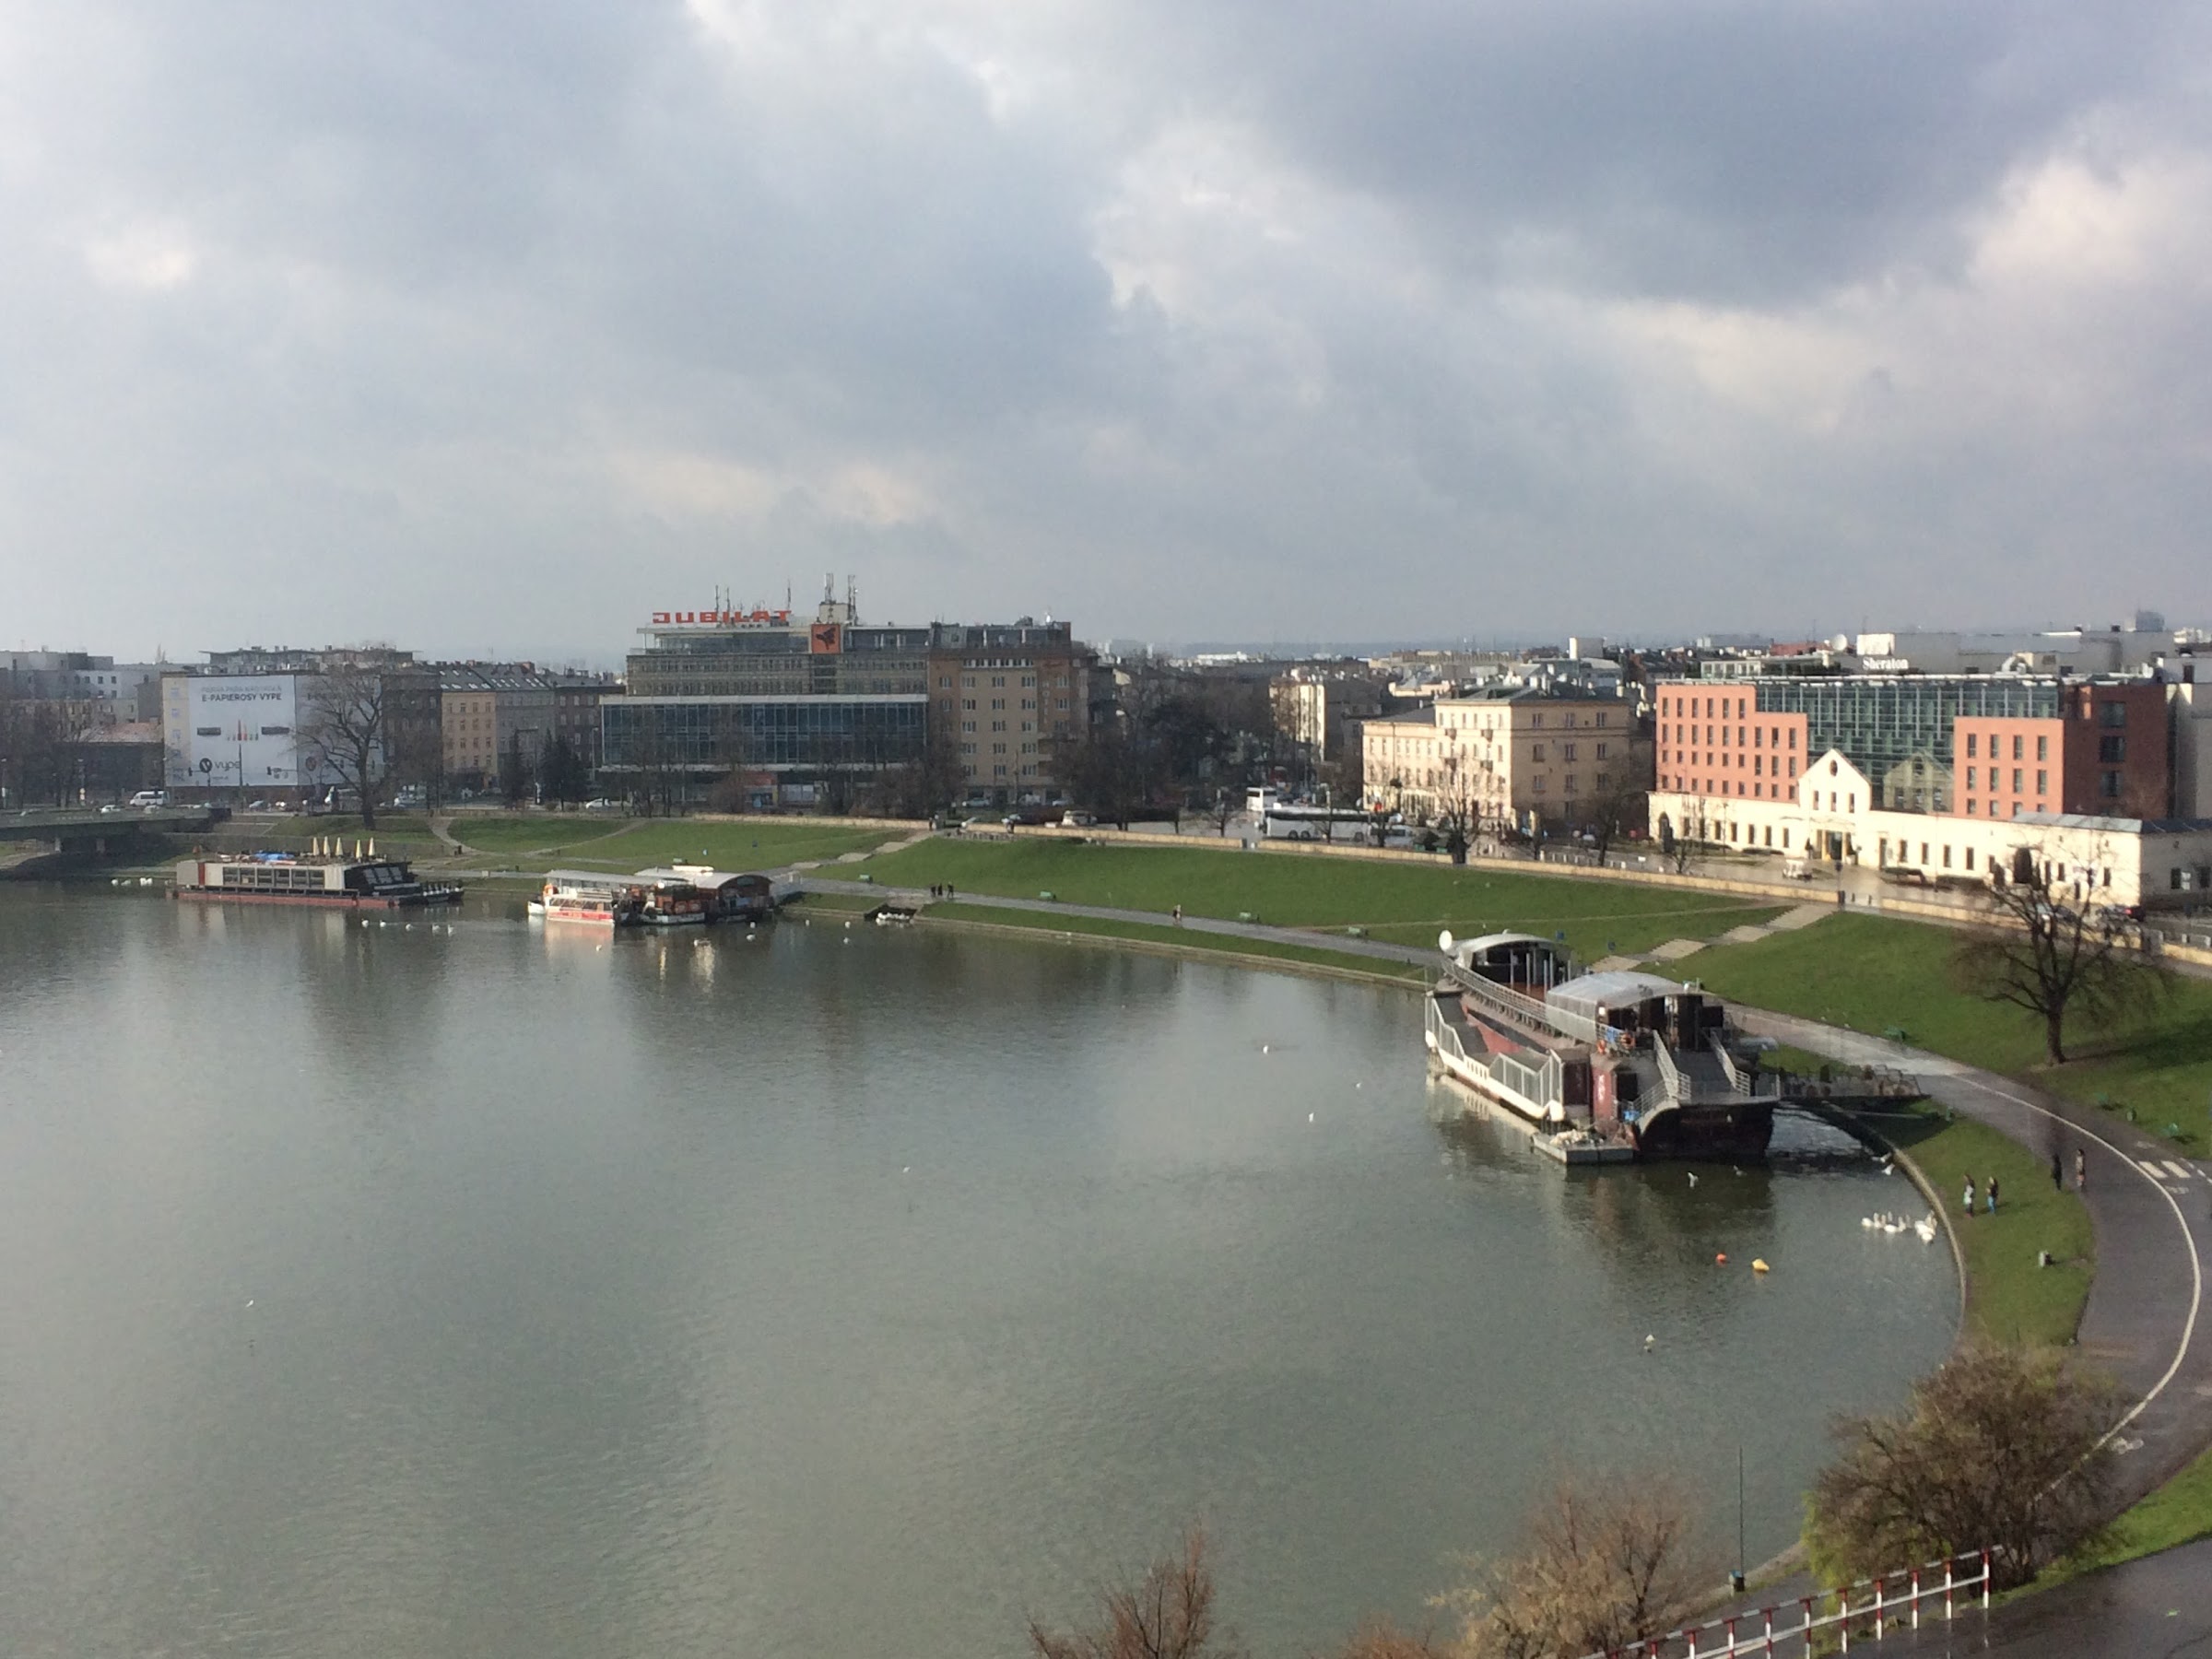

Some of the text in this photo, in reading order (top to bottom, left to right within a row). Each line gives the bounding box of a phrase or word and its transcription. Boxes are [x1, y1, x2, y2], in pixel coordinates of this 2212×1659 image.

[653, 610, 792, 624] JUBILAT
[1863, 656, 1909, 670] Sheraton
[202, 693, 257, 701] E-PAPIEROSY
[215, 760, 241, 772] vype
